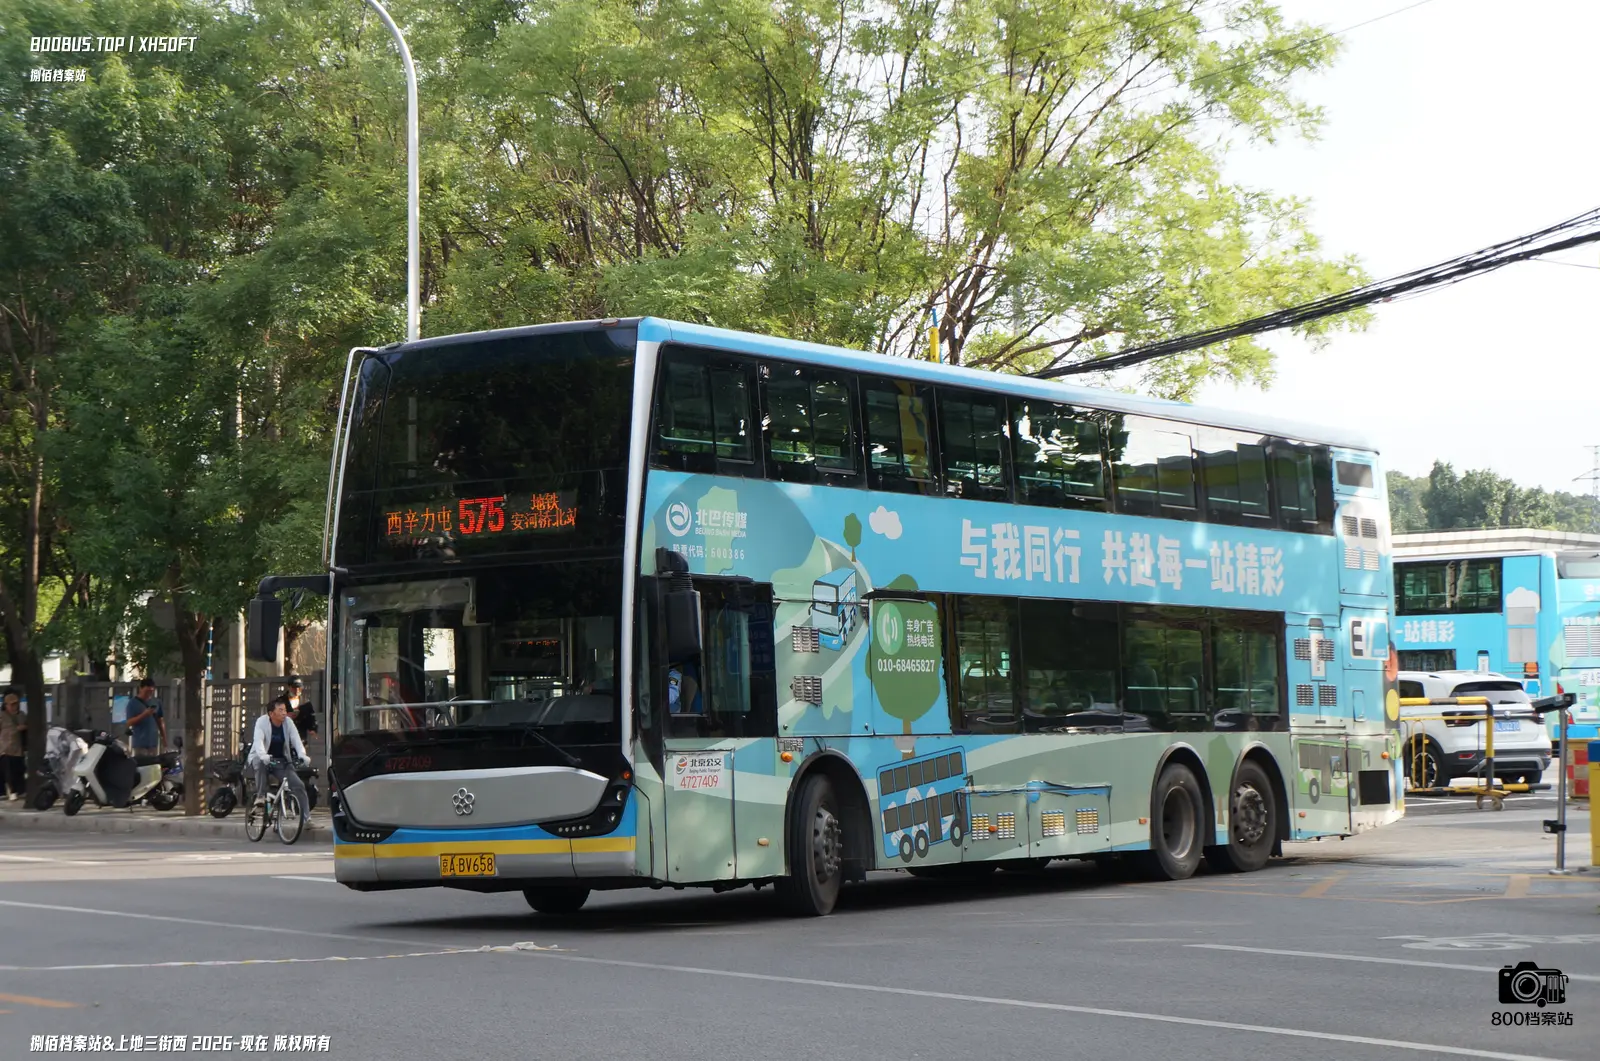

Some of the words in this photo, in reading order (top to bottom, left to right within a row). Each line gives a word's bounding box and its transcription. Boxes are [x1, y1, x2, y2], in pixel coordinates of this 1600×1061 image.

[530, 492, 559, 510] 地铁
[386, 506, 452, 535] 西辛力屯
[458, 496, 505, 534] 575
[695, 509, 747, 528] 北巴传媒
[960, 518, 1081, 583] 与我同行
[1101, 530, 1284, 596] 共赴每一站精彩
[906, 618, 933, 632] 车身广告
[906, 634, 934, 647] 热线电话
[877, 658, 935, 672] 010-68465827
[385, 755, 432, 770] 4727409
[690, 758, 721, 767] 北京公交
[680, 775, 719, 789] 4727409
